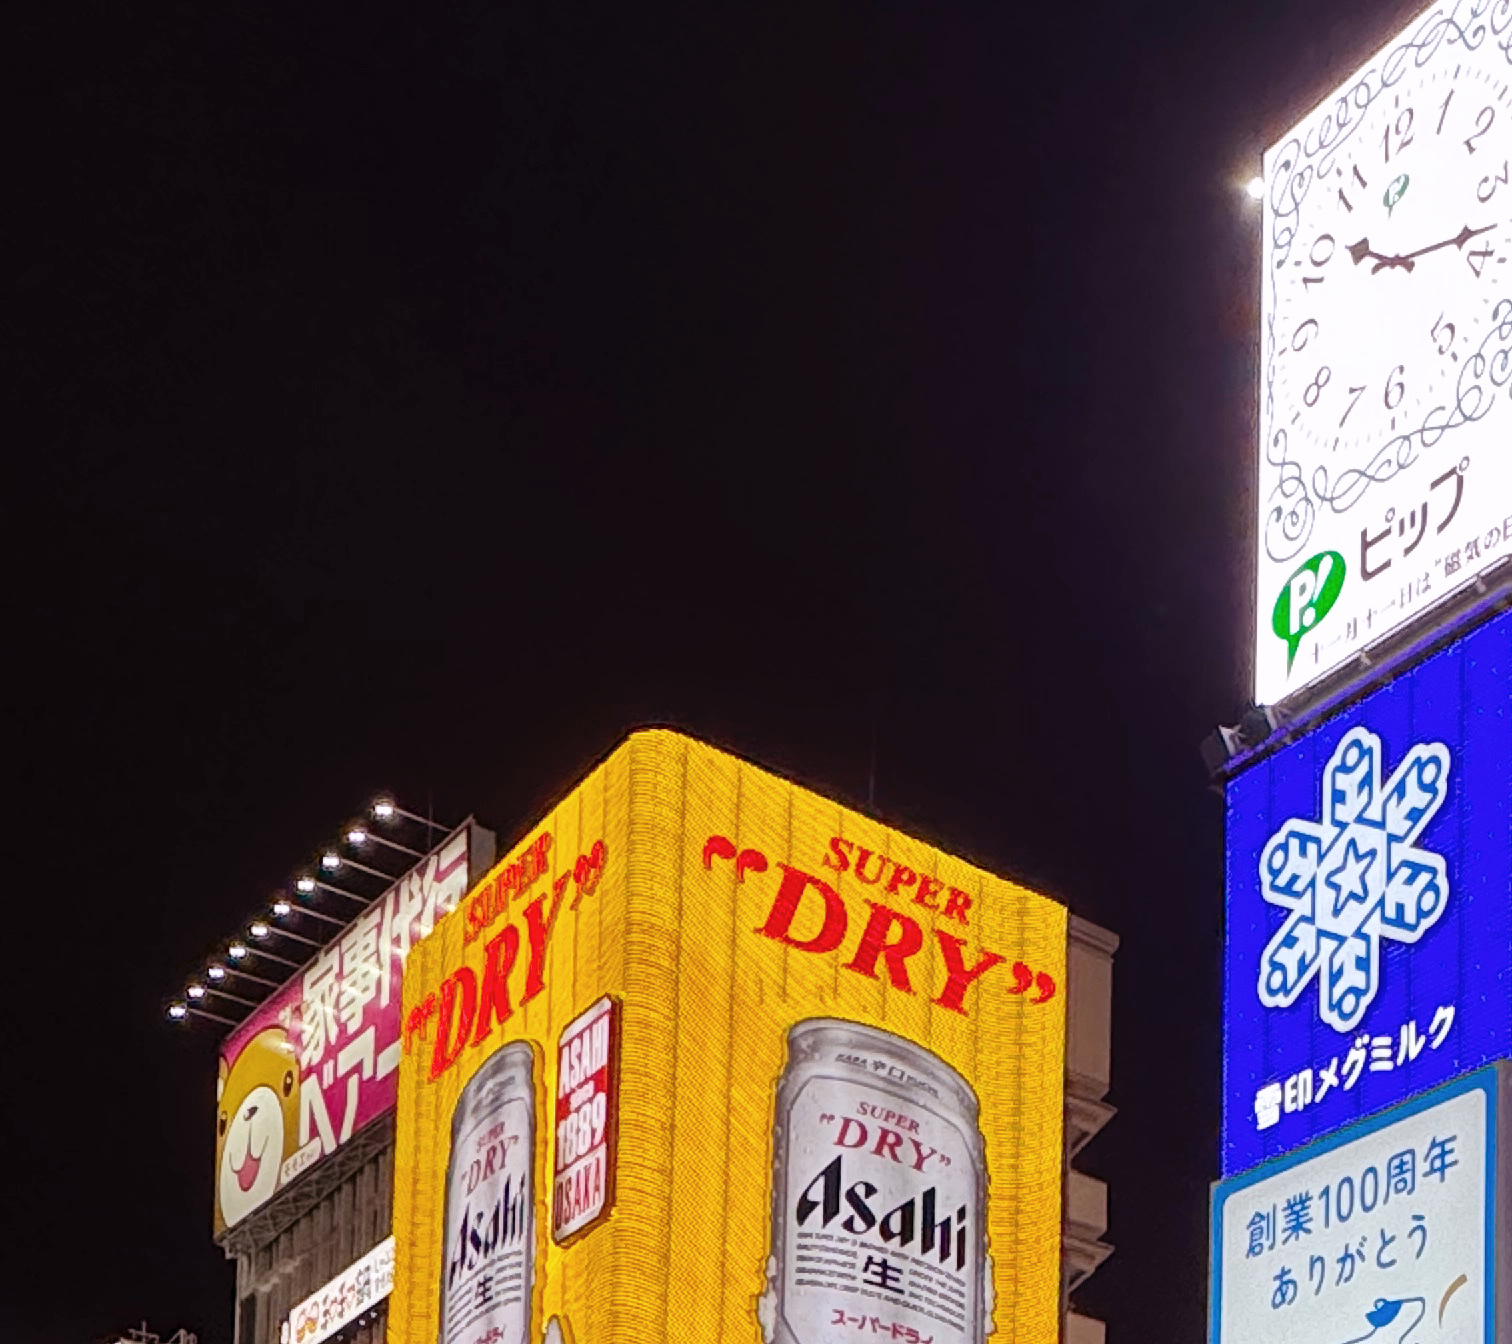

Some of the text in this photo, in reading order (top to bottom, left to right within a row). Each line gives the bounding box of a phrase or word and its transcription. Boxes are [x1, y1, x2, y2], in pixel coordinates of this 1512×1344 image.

[1378, 107, 1416, 163] 12
[1434, 88, 1456, 136] 1
[1463, 105, 1496, 156] 2
[1337, 164, 1369, 214] 11
[1476, 162, 1509, 204] 3
[1302, 233, 1336, 291] 10
[1466, 238, 1496, 279] 4
[1291, 317, 1319, 354] 9
[1431, 312, 1457, 355] 5
[1302, 365, 1332, 407] 8
[1338, 385, 1367, 428] 7
[1383, 364, 1405, 409] 6
[1359, 456, 1471, 583] ピップ
[822, 836, 974, 926] SUPER
[1254, 1003, 1456, 1132] 雪印メグミルク
[556, 1091, 608, 1171] 1889
[856, 1100, 921, 1136] SUPER
[553, 1155, 602, 1232] OSAKA
[795, 1153, 969, 1272] Asahi
[1245, 1134, 1460, 1260] 創業100周年
[448, 1170, 528, 1293] Asahi
[862, 1254, 906, 1296] 生
[1270, 1214, 1429, 1310] ありがとう
